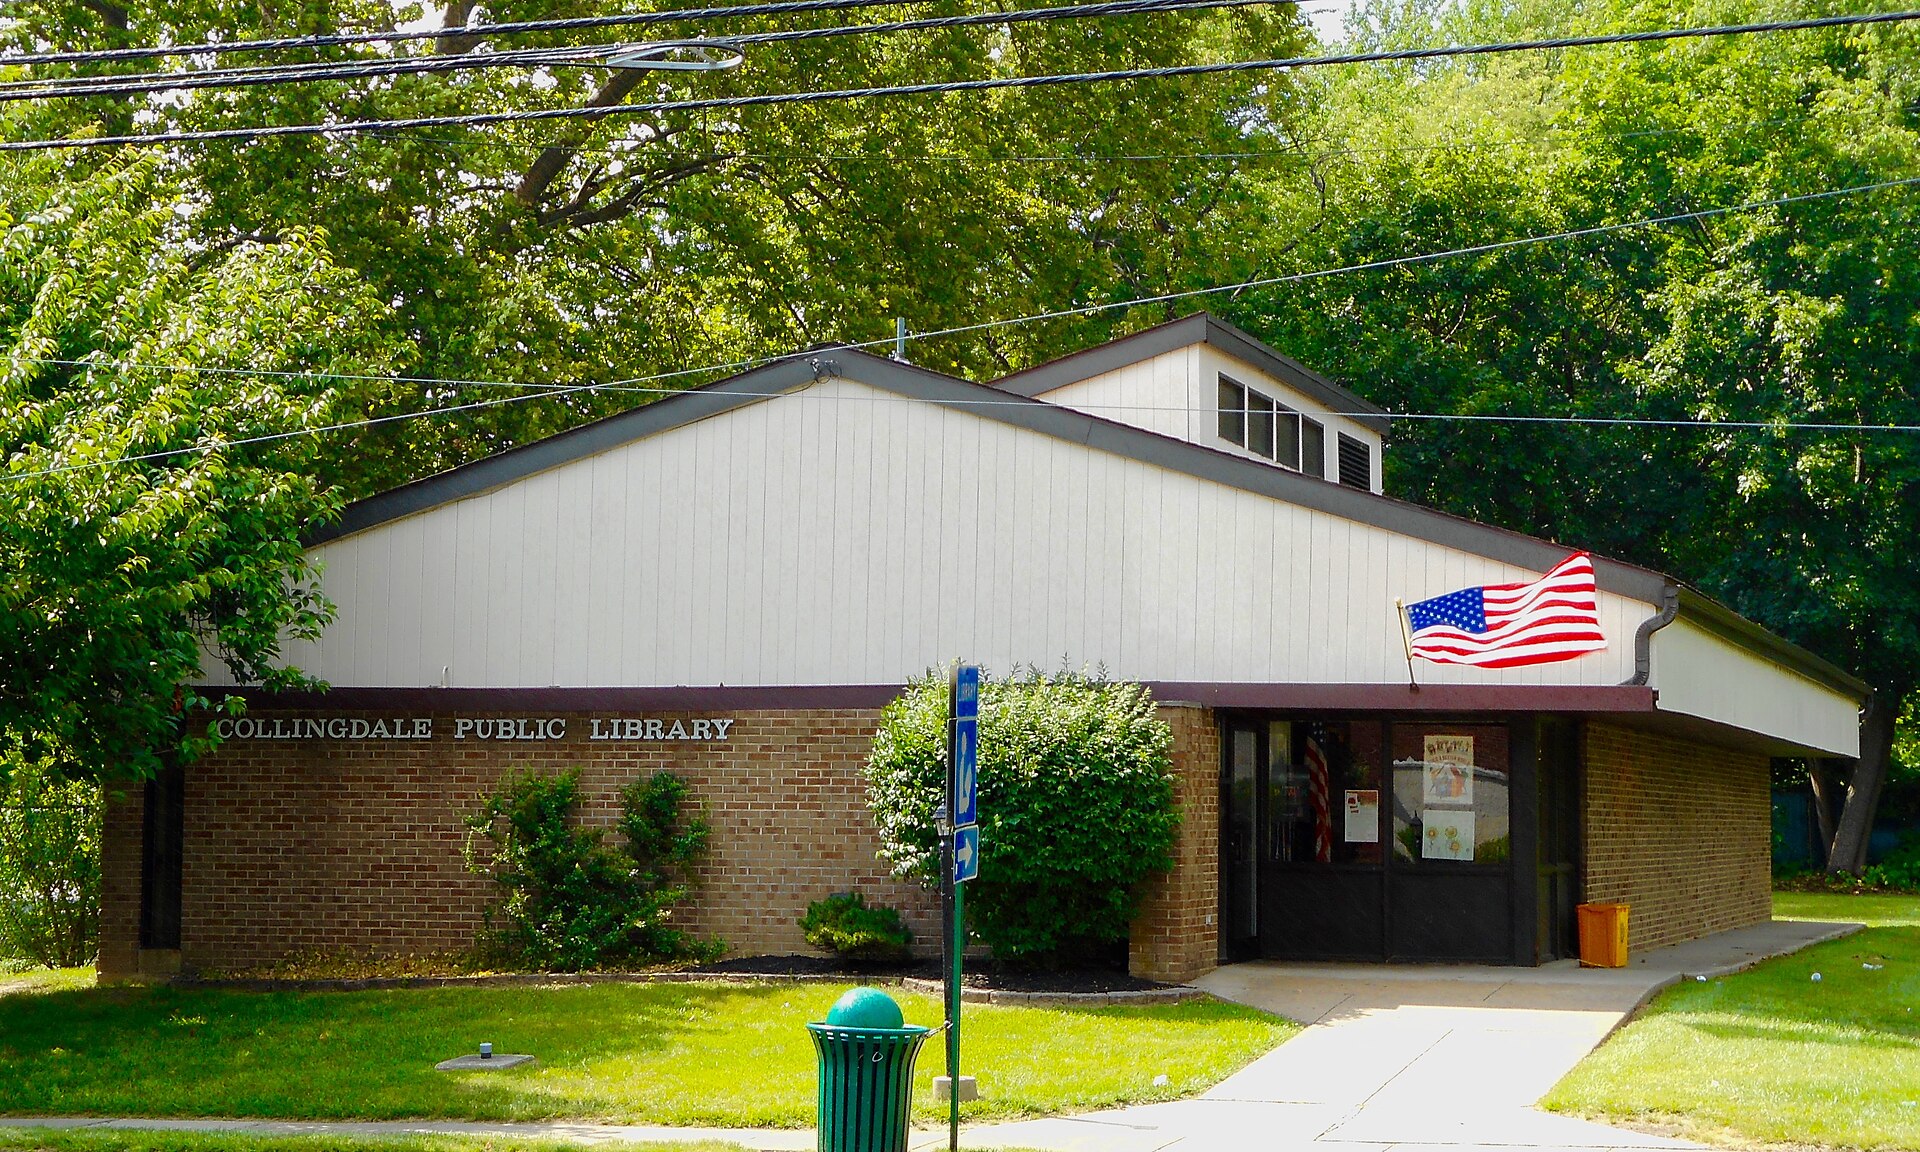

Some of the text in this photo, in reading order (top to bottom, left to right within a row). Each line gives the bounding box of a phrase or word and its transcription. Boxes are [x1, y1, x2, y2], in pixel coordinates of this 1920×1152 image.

[216, 718, 734, 740] COLLINGDALE PUBLIC LIBRARY
